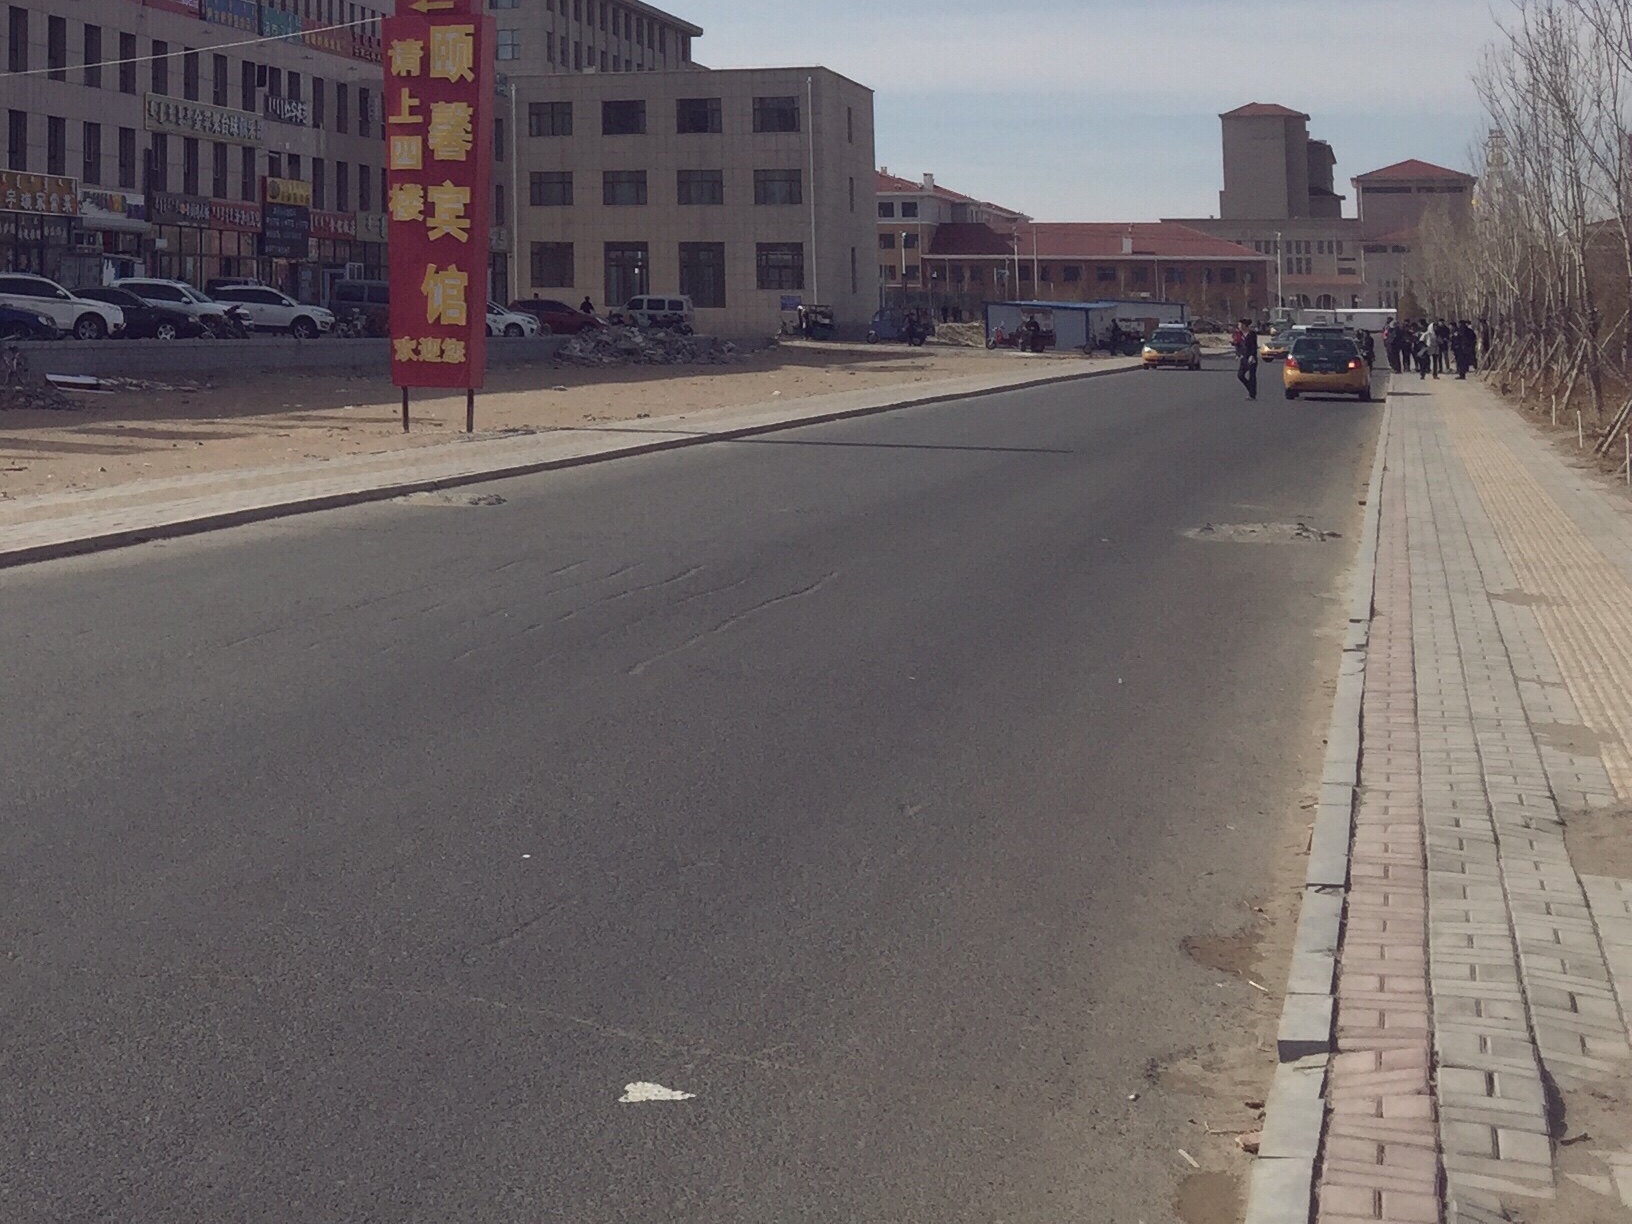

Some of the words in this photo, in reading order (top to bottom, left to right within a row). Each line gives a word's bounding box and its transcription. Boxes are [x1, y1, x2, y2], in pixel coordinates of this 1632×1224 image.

[388, 39, 426, 224] 请上四楼
[421, 24, 476, 327] 颐馨宾馆
[393, 336, 466, 364] 欢迎您
